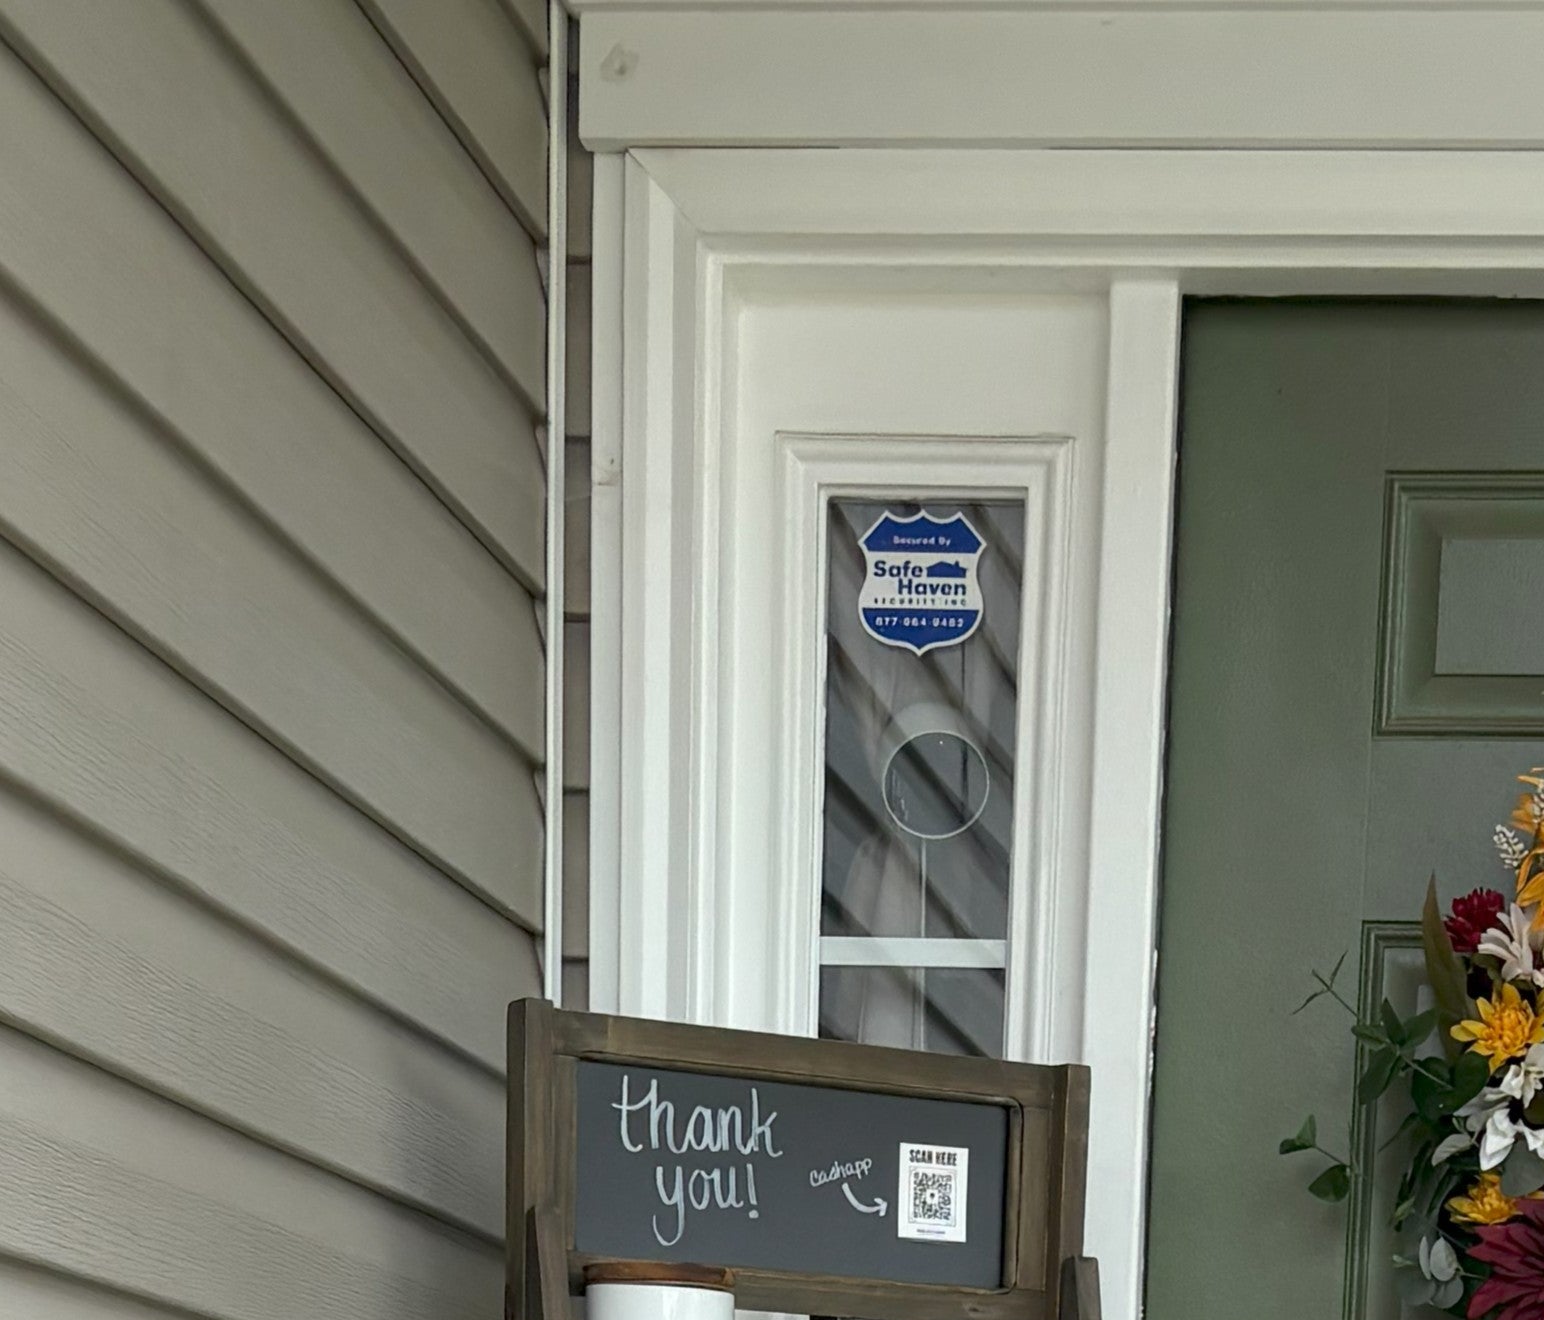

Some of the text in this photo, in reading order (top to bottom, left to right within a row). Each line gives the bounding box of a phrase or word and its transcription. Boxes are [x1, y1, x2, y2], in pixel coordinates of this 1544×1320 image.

[873, 560, 923, 578] Safe
[898, 578, 967, 596] Haven
[611, 1074, 784, 1158] thank
[909, 1149, 958, 1167] SCAN HERE
[652, 1163, 759, 1247] you!
